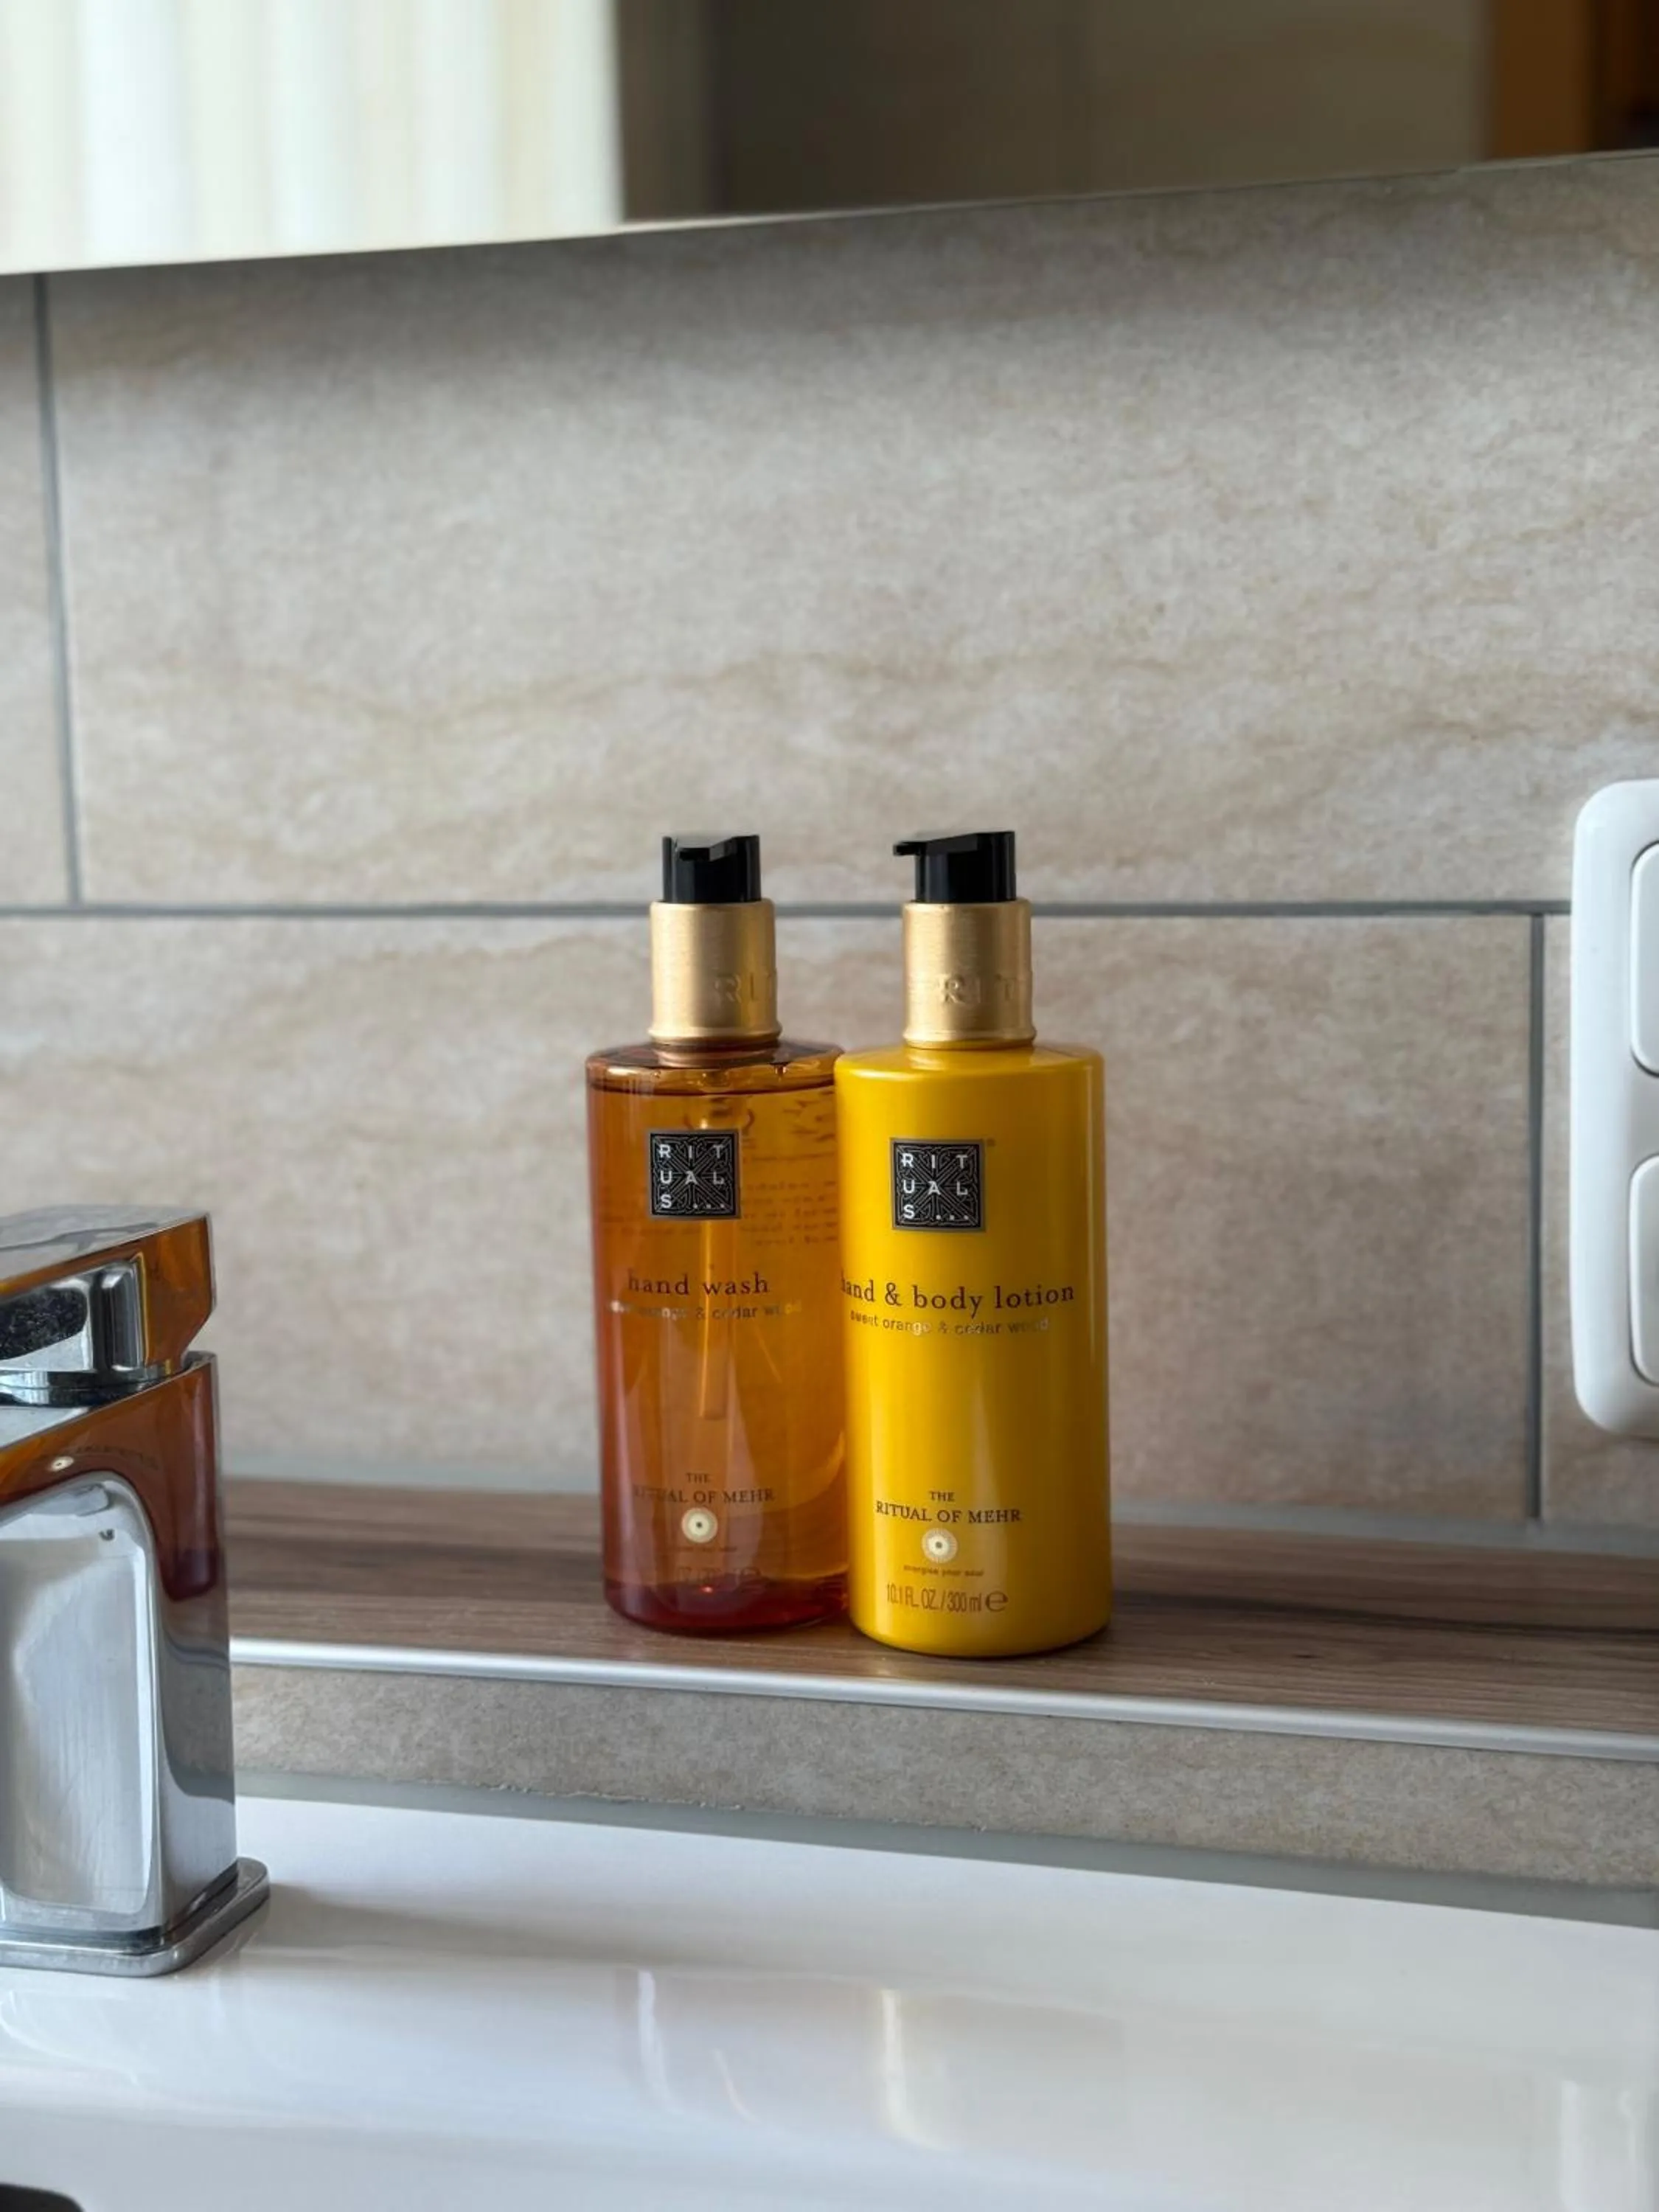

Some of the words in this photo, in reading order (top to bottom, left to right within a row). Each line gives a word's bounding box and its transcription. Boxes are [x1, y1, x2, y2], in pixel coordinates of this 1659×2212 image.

[627, 1267, 690, 1295] hand
[703, 1271, 770, 1295] wash
[884, 1282, 902, 1307] &
[913, 1285, 983, 1319] body
[993, 1284, 1074, 1309] lotion
[850, 1310, 878, 1326] sweet
[883, 1318, 931, 1336] orange
[685, 1472, 712, 1484] THE
[693, 1489, 717, 1504] OF
[722, 1487, 776, 1503] MEHR
[928, 1491, 956, 1503] THE
[875, 1500, 933, 1523] RITUAL
[936, 1509, 963, 1523] OF
[967, 1508, 1021, 1524] MEHR
